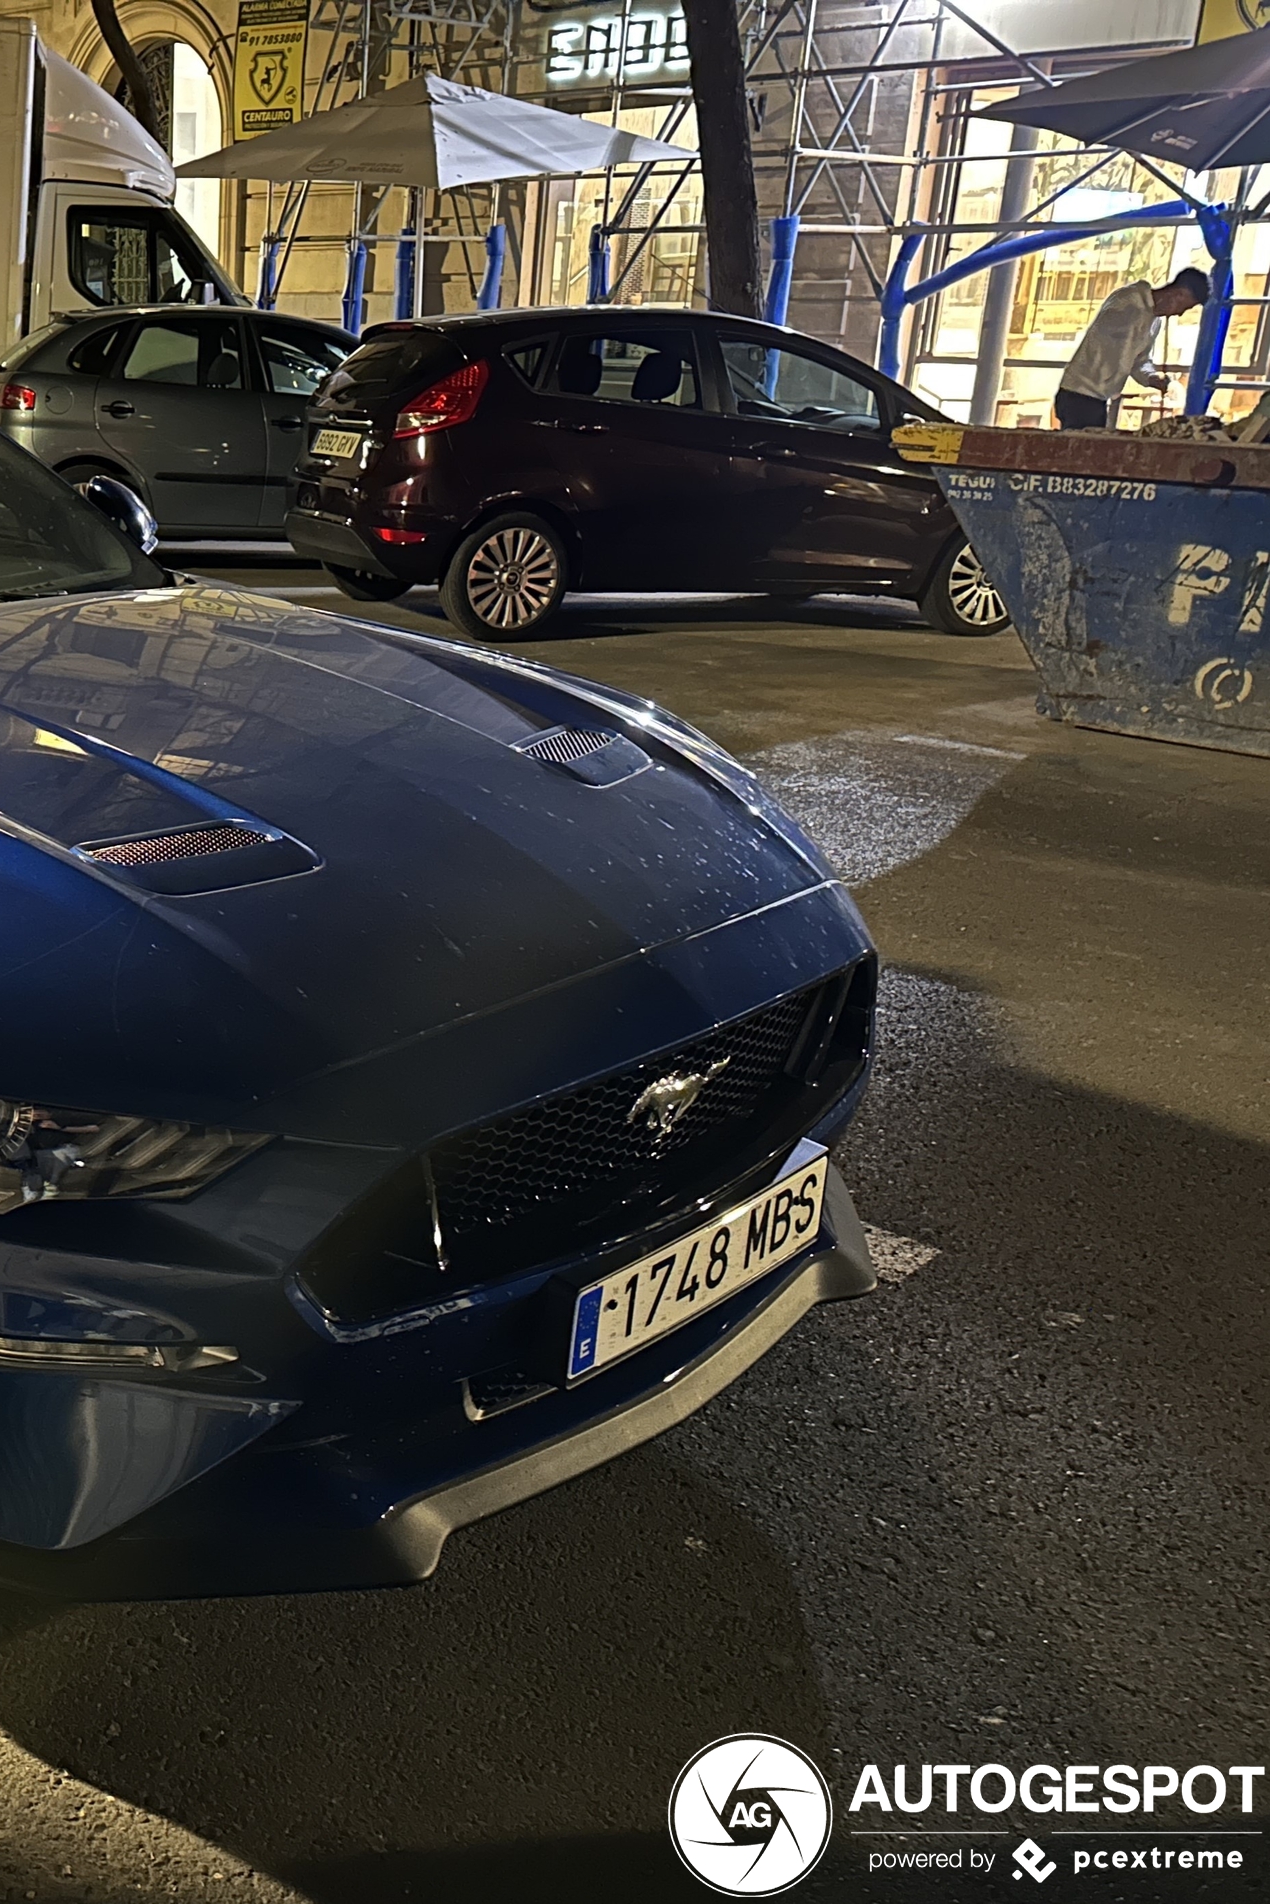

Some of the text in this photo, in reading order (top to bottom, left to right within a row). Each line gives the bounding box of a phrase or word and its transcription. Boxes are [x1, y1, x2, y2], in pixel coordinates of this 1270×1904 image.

[249, 35, 261, 46] 91
[243, 110, 292, 123] CENTAURO
[1047, 476, 1157, 501] B83287276
[624, 1173, 817, 1338] 1748 MBS
[579, 1338, 591, 1358] E
